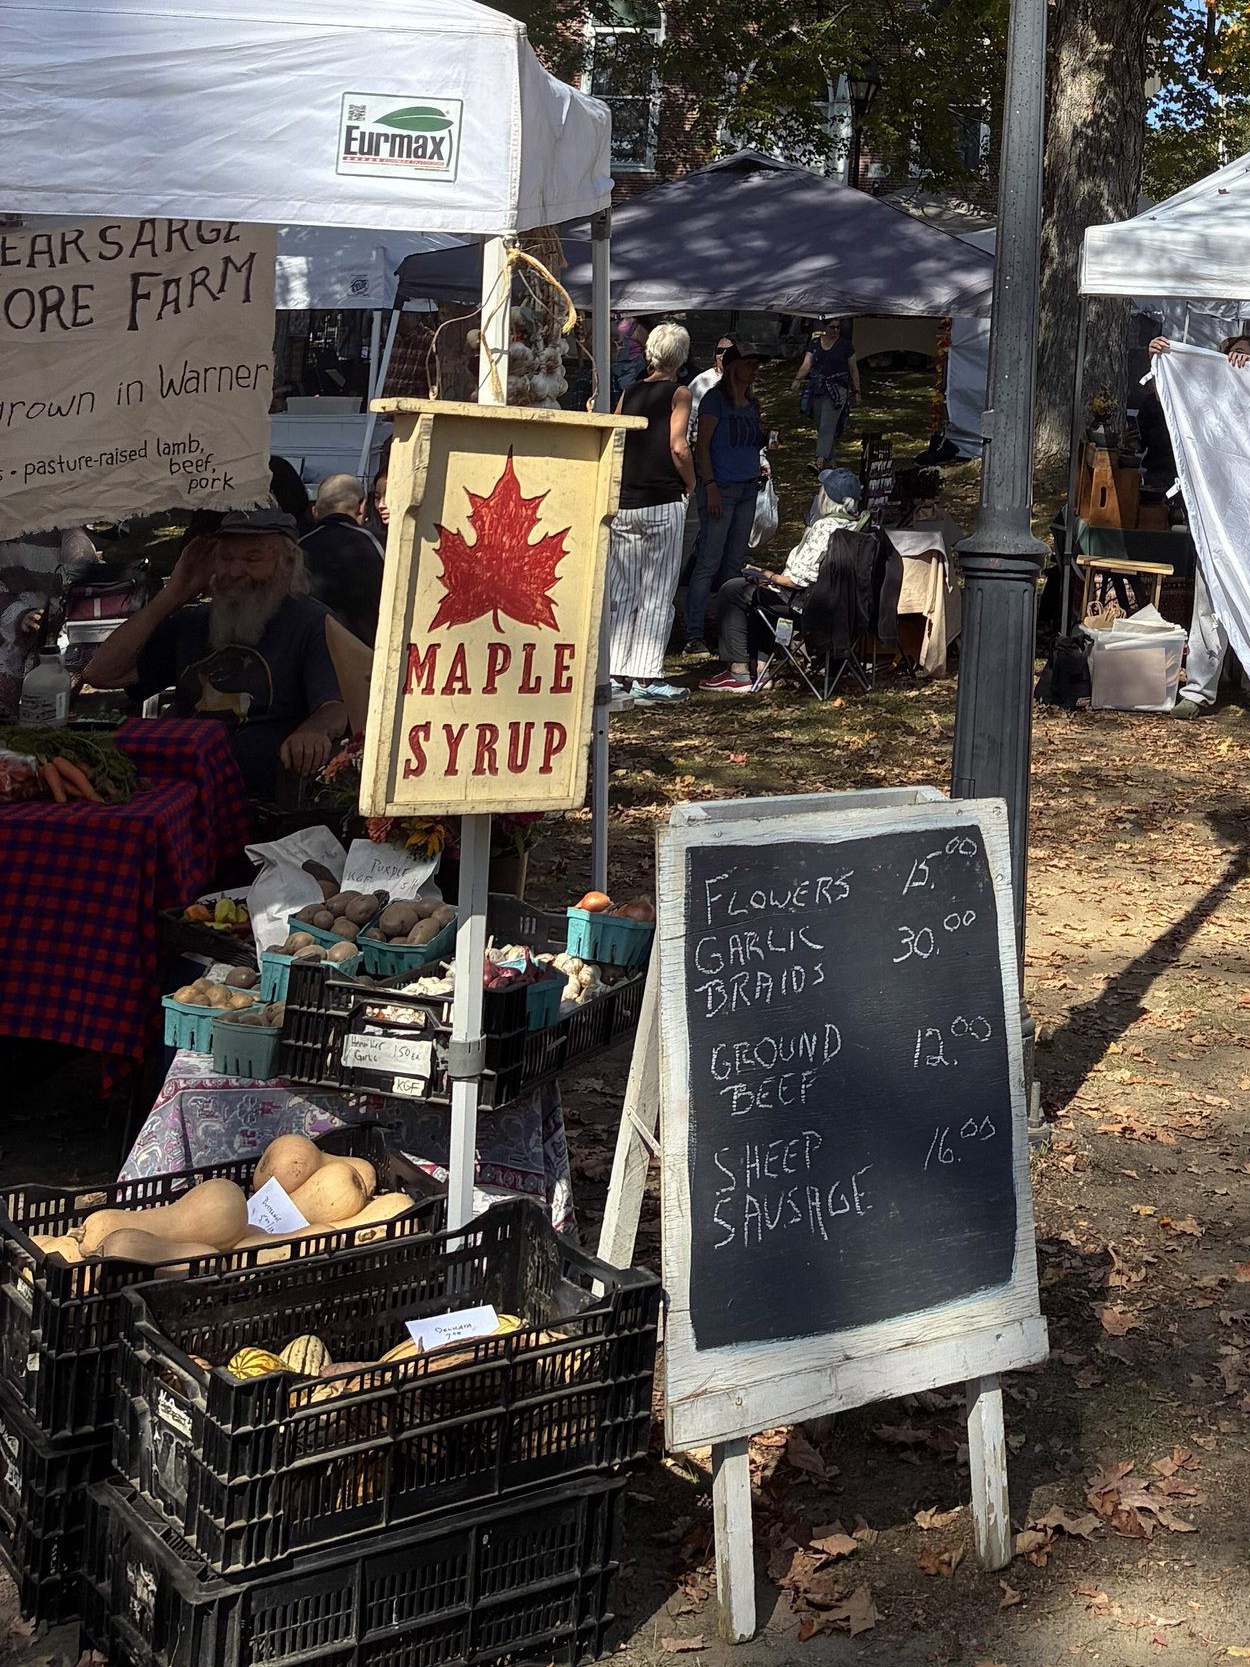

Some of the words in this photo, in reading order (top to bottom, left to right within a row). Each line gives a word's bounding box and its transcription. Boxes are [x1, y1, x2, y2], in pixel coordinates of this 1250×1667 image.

[344, 125, 446, 161] Eurmax
[4, 284, 94, 332] ORE
[127, 252, 257, 331] FARM
[117, 380, 143, 406] in
[159, 360, 269, 399] Warner
[24, 440, 148, 484] pasture-raised
[157, 433, 205, 458] lamb,
[169, 453, 216, 476] beef,
[188, 472, 235, 494] pork
[402, 642, 576, 696] MAPLE
[402, 721, 568, 780] SYRUP
[705, 870, 855, 926] FLOWERS
[694, 925, 825, 975] GARLIC
[694, 962, 825, 1019] BRAIDS
[710, 1022, 843, 1081] GROUND
[396, 1079, 420, 1093] KGF
[719, 1068, 819, 1117] BEEF
[714, 1130, 823, 1197] SHEEP
[713, 1164, 875, 1250] SAUSAGE
